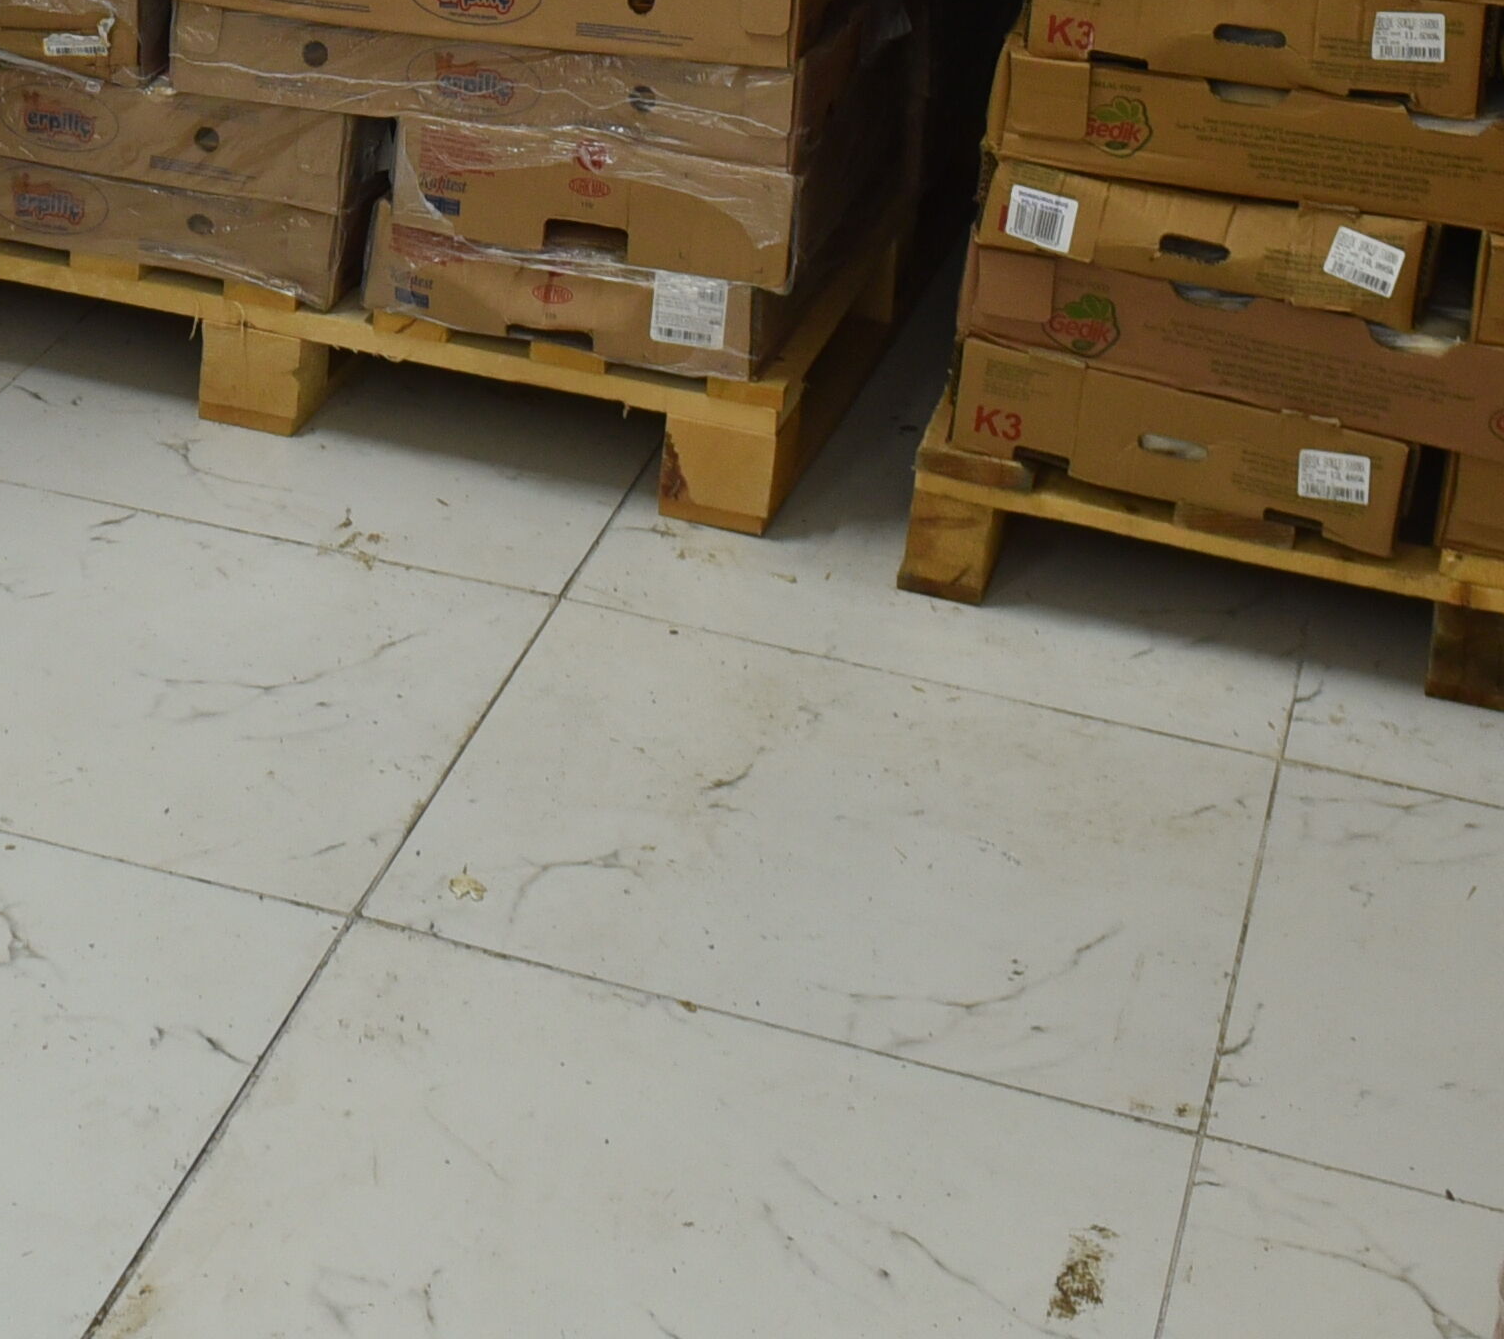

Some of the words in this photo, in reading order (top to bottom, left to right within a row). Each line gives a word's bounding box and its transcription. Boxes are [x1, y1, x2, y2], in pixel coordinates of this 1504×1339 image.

[1047, 15, 1096, 51] K3
[1046, 315, 1112, 339] Gedik
[973, 405, 1023, 440] K3
